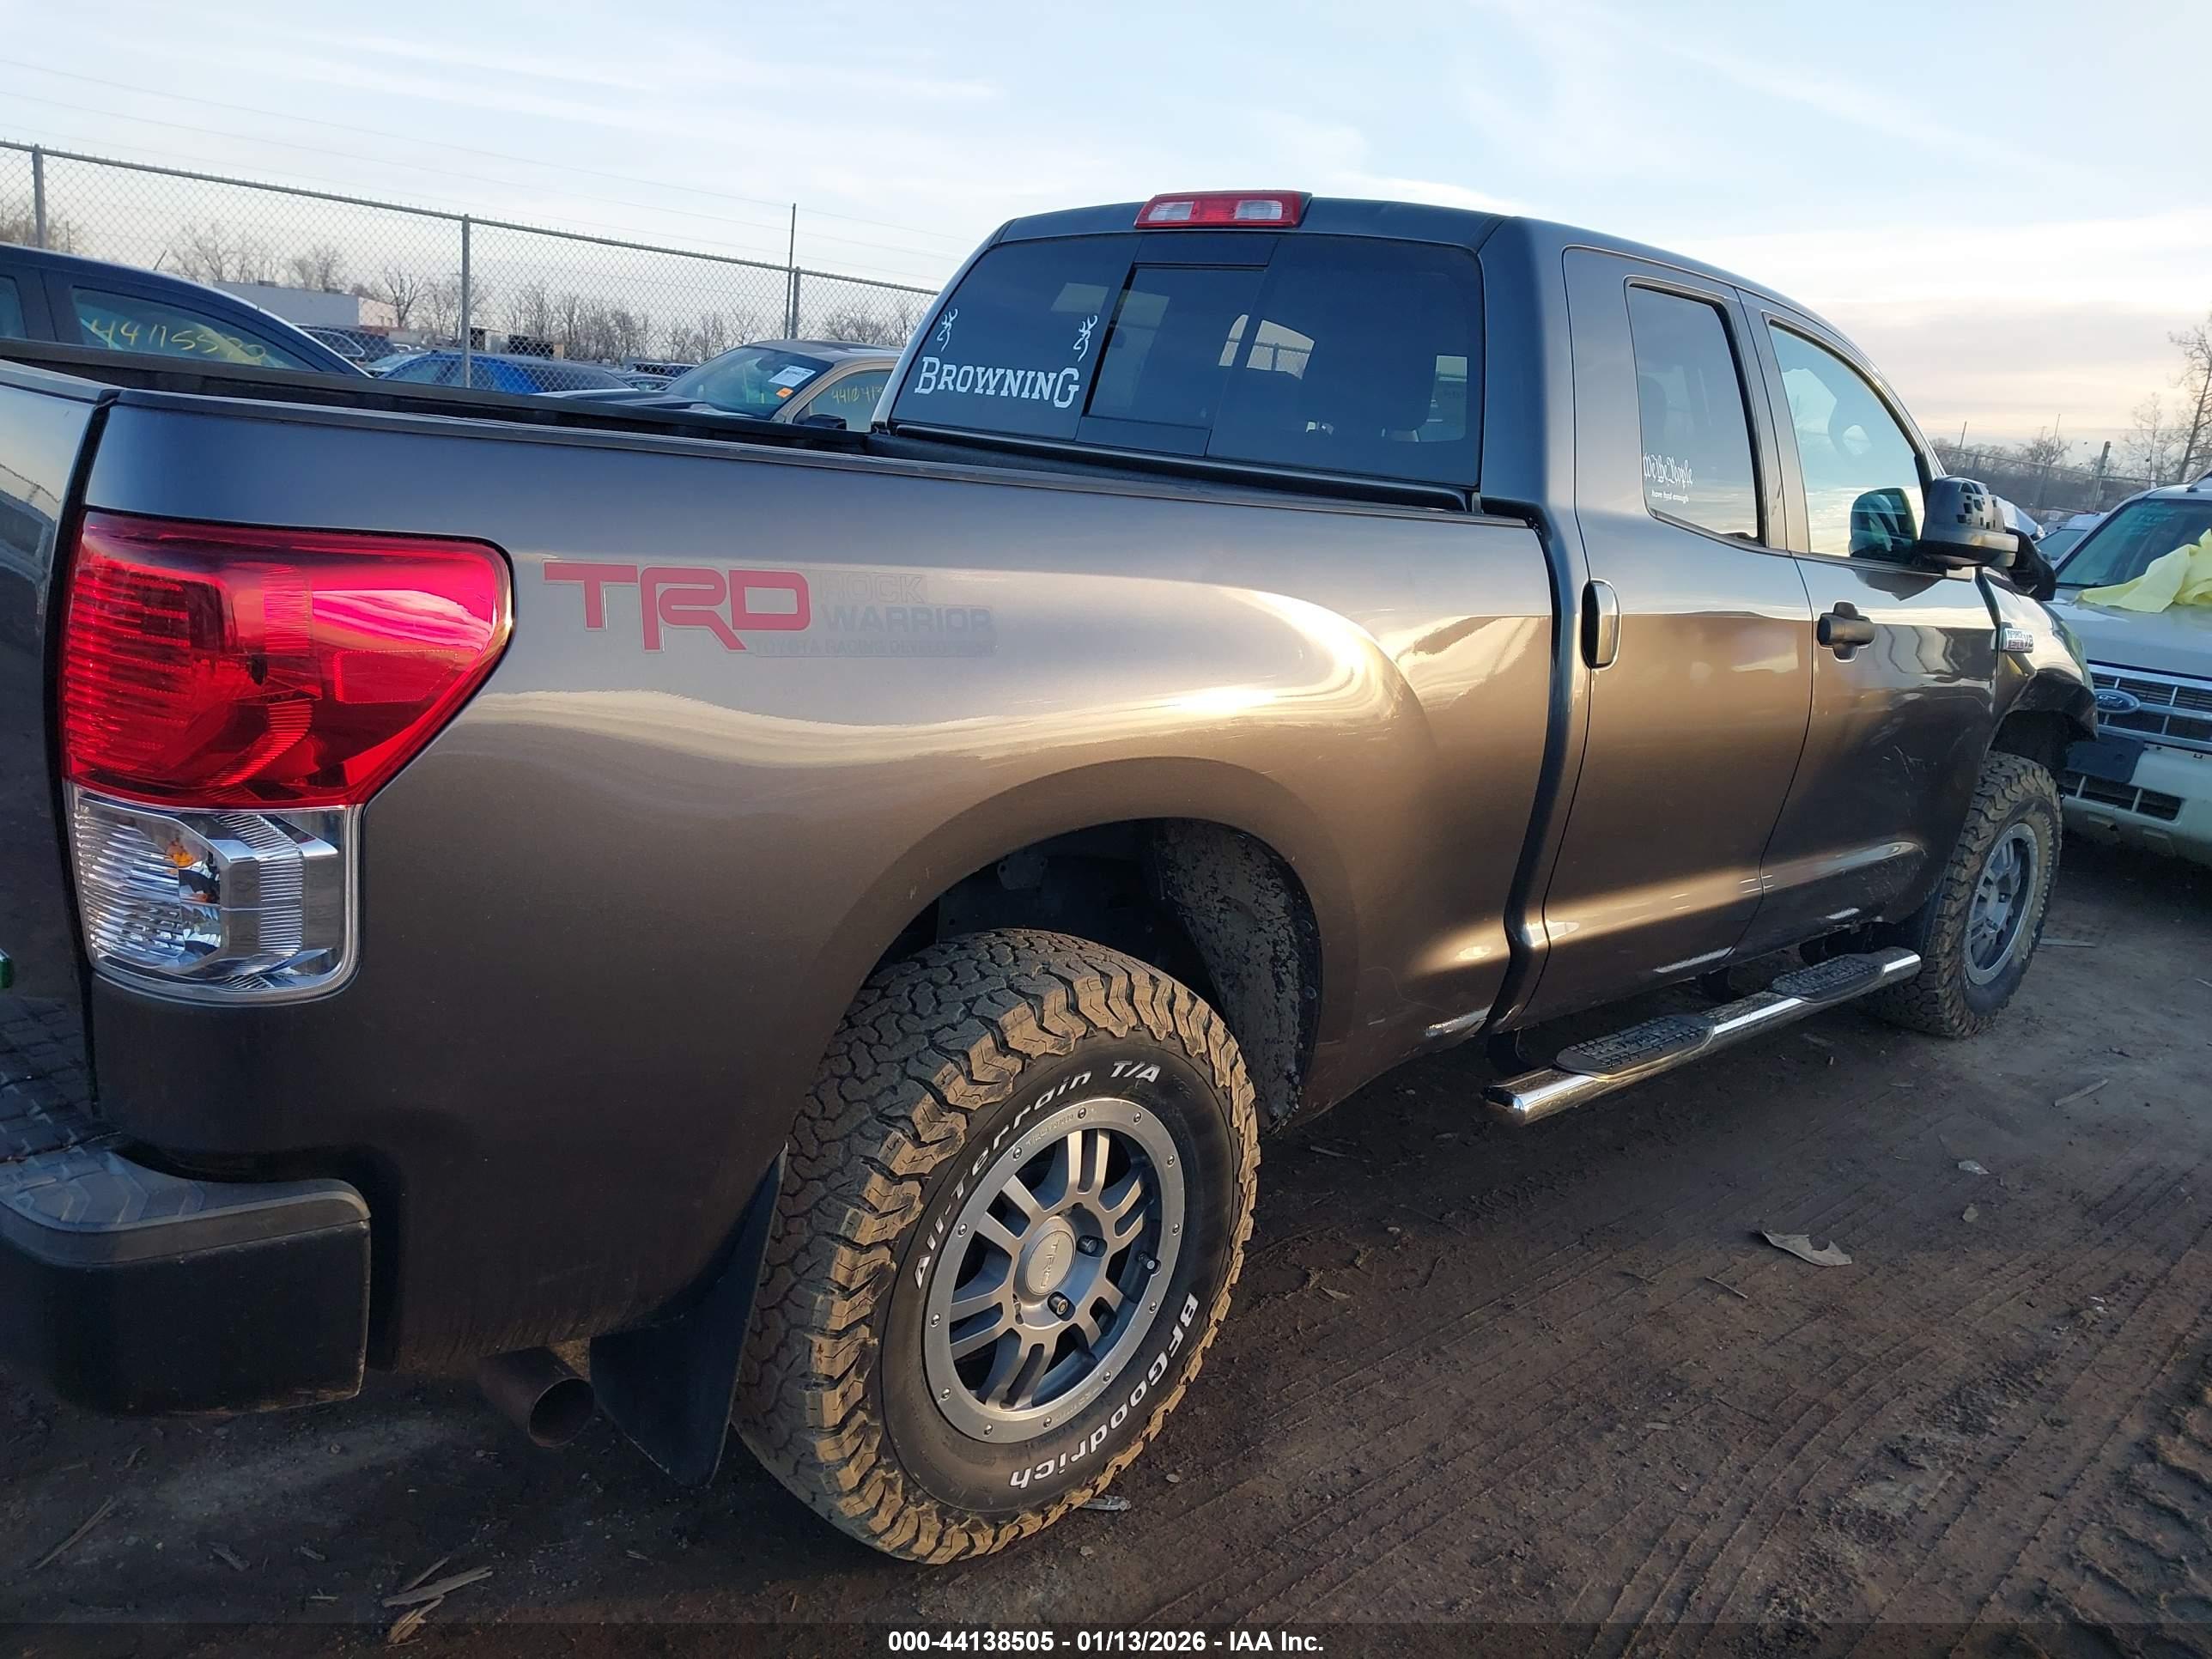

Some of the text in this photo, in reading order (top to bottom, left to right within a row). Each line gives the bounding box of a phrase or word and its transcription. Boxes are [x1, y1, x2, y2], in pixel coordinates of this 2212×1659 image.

[914, 356, 1079, 409] BROWNING
[544, 562, 811, 650] TRD
[822, 605, 996, 634] WARRIOR
[1110, 1060, 1161, 1083] T/A
